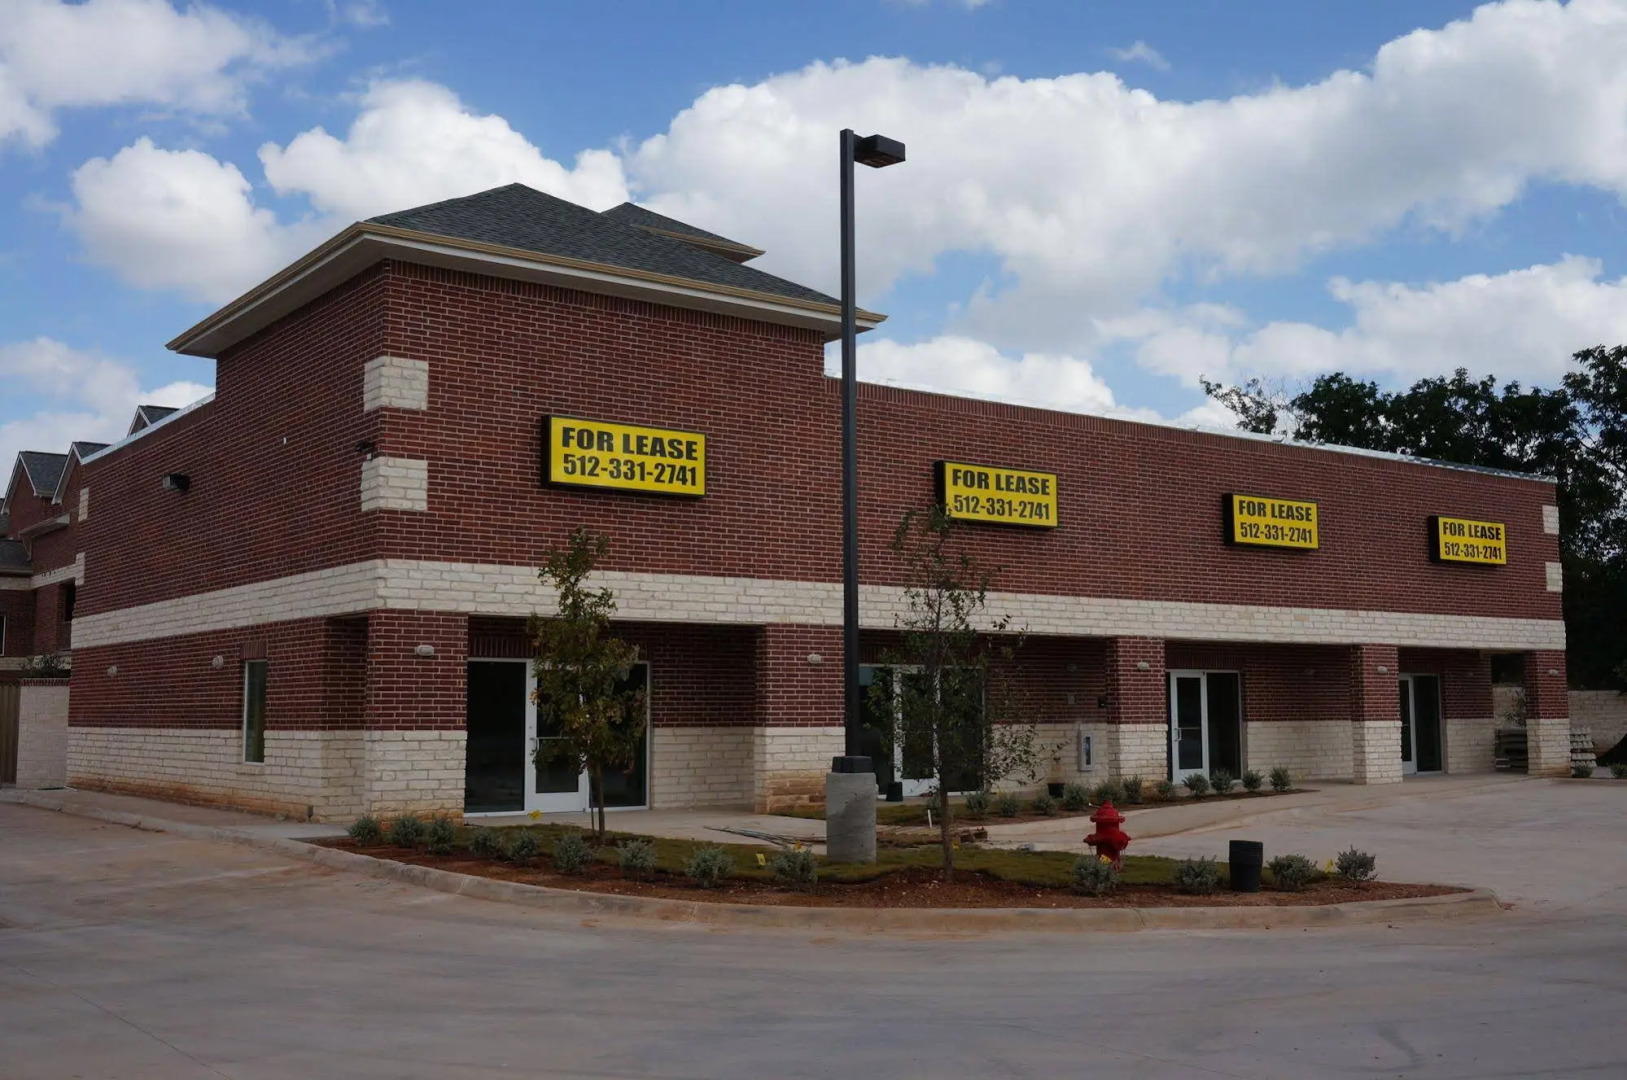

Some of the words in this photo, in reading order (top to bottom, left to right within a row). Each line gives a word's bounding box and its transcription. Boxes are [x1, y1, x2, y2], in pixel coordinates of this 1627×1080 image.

[562, 426, 614, 452] FOR
[622, 433, 698, 461] LEASE
[563, 453, 697, 487] 512-331-2741
[952, 468, 990, 490] FOR
[995, 473, 1050, 496] LEASE
[953, 494, 1050, 520] 512-331-2741
[1238, 499, 1267, 518] FOR
[1270, 503, 1313, 522] LEASE
[1240, 521, 1313, 544] 512-331-2741
[1442, 521, 1465, 537] FOR
[1468, 524, 1502, 541] LEASE
[1444, 541, 1502, 560] 512-331-2741
